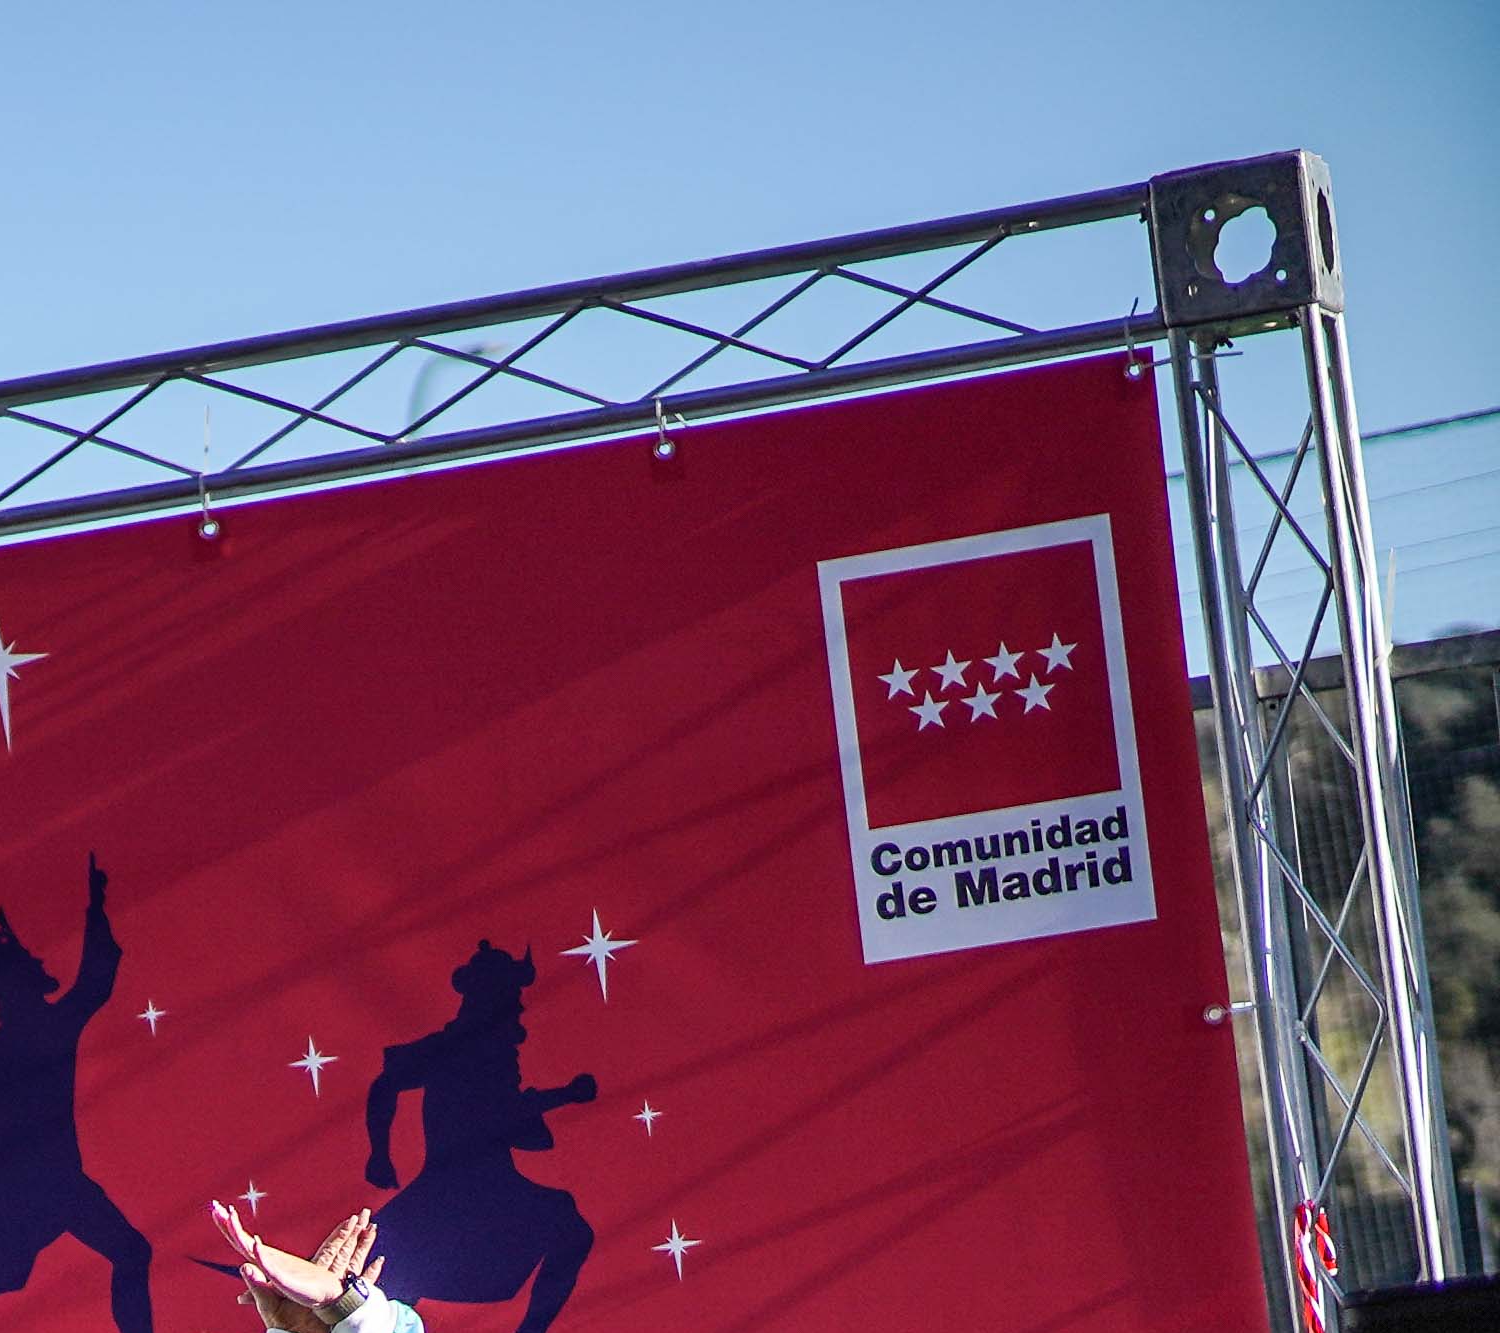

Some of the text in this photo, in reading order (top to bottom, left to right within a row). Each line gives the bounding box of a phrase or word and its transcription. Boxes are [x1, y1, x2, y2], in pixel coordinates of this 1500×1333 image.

[870, 805, 1129, 876] Comunidad
[876, 846, 1132, 919] de Madrid
